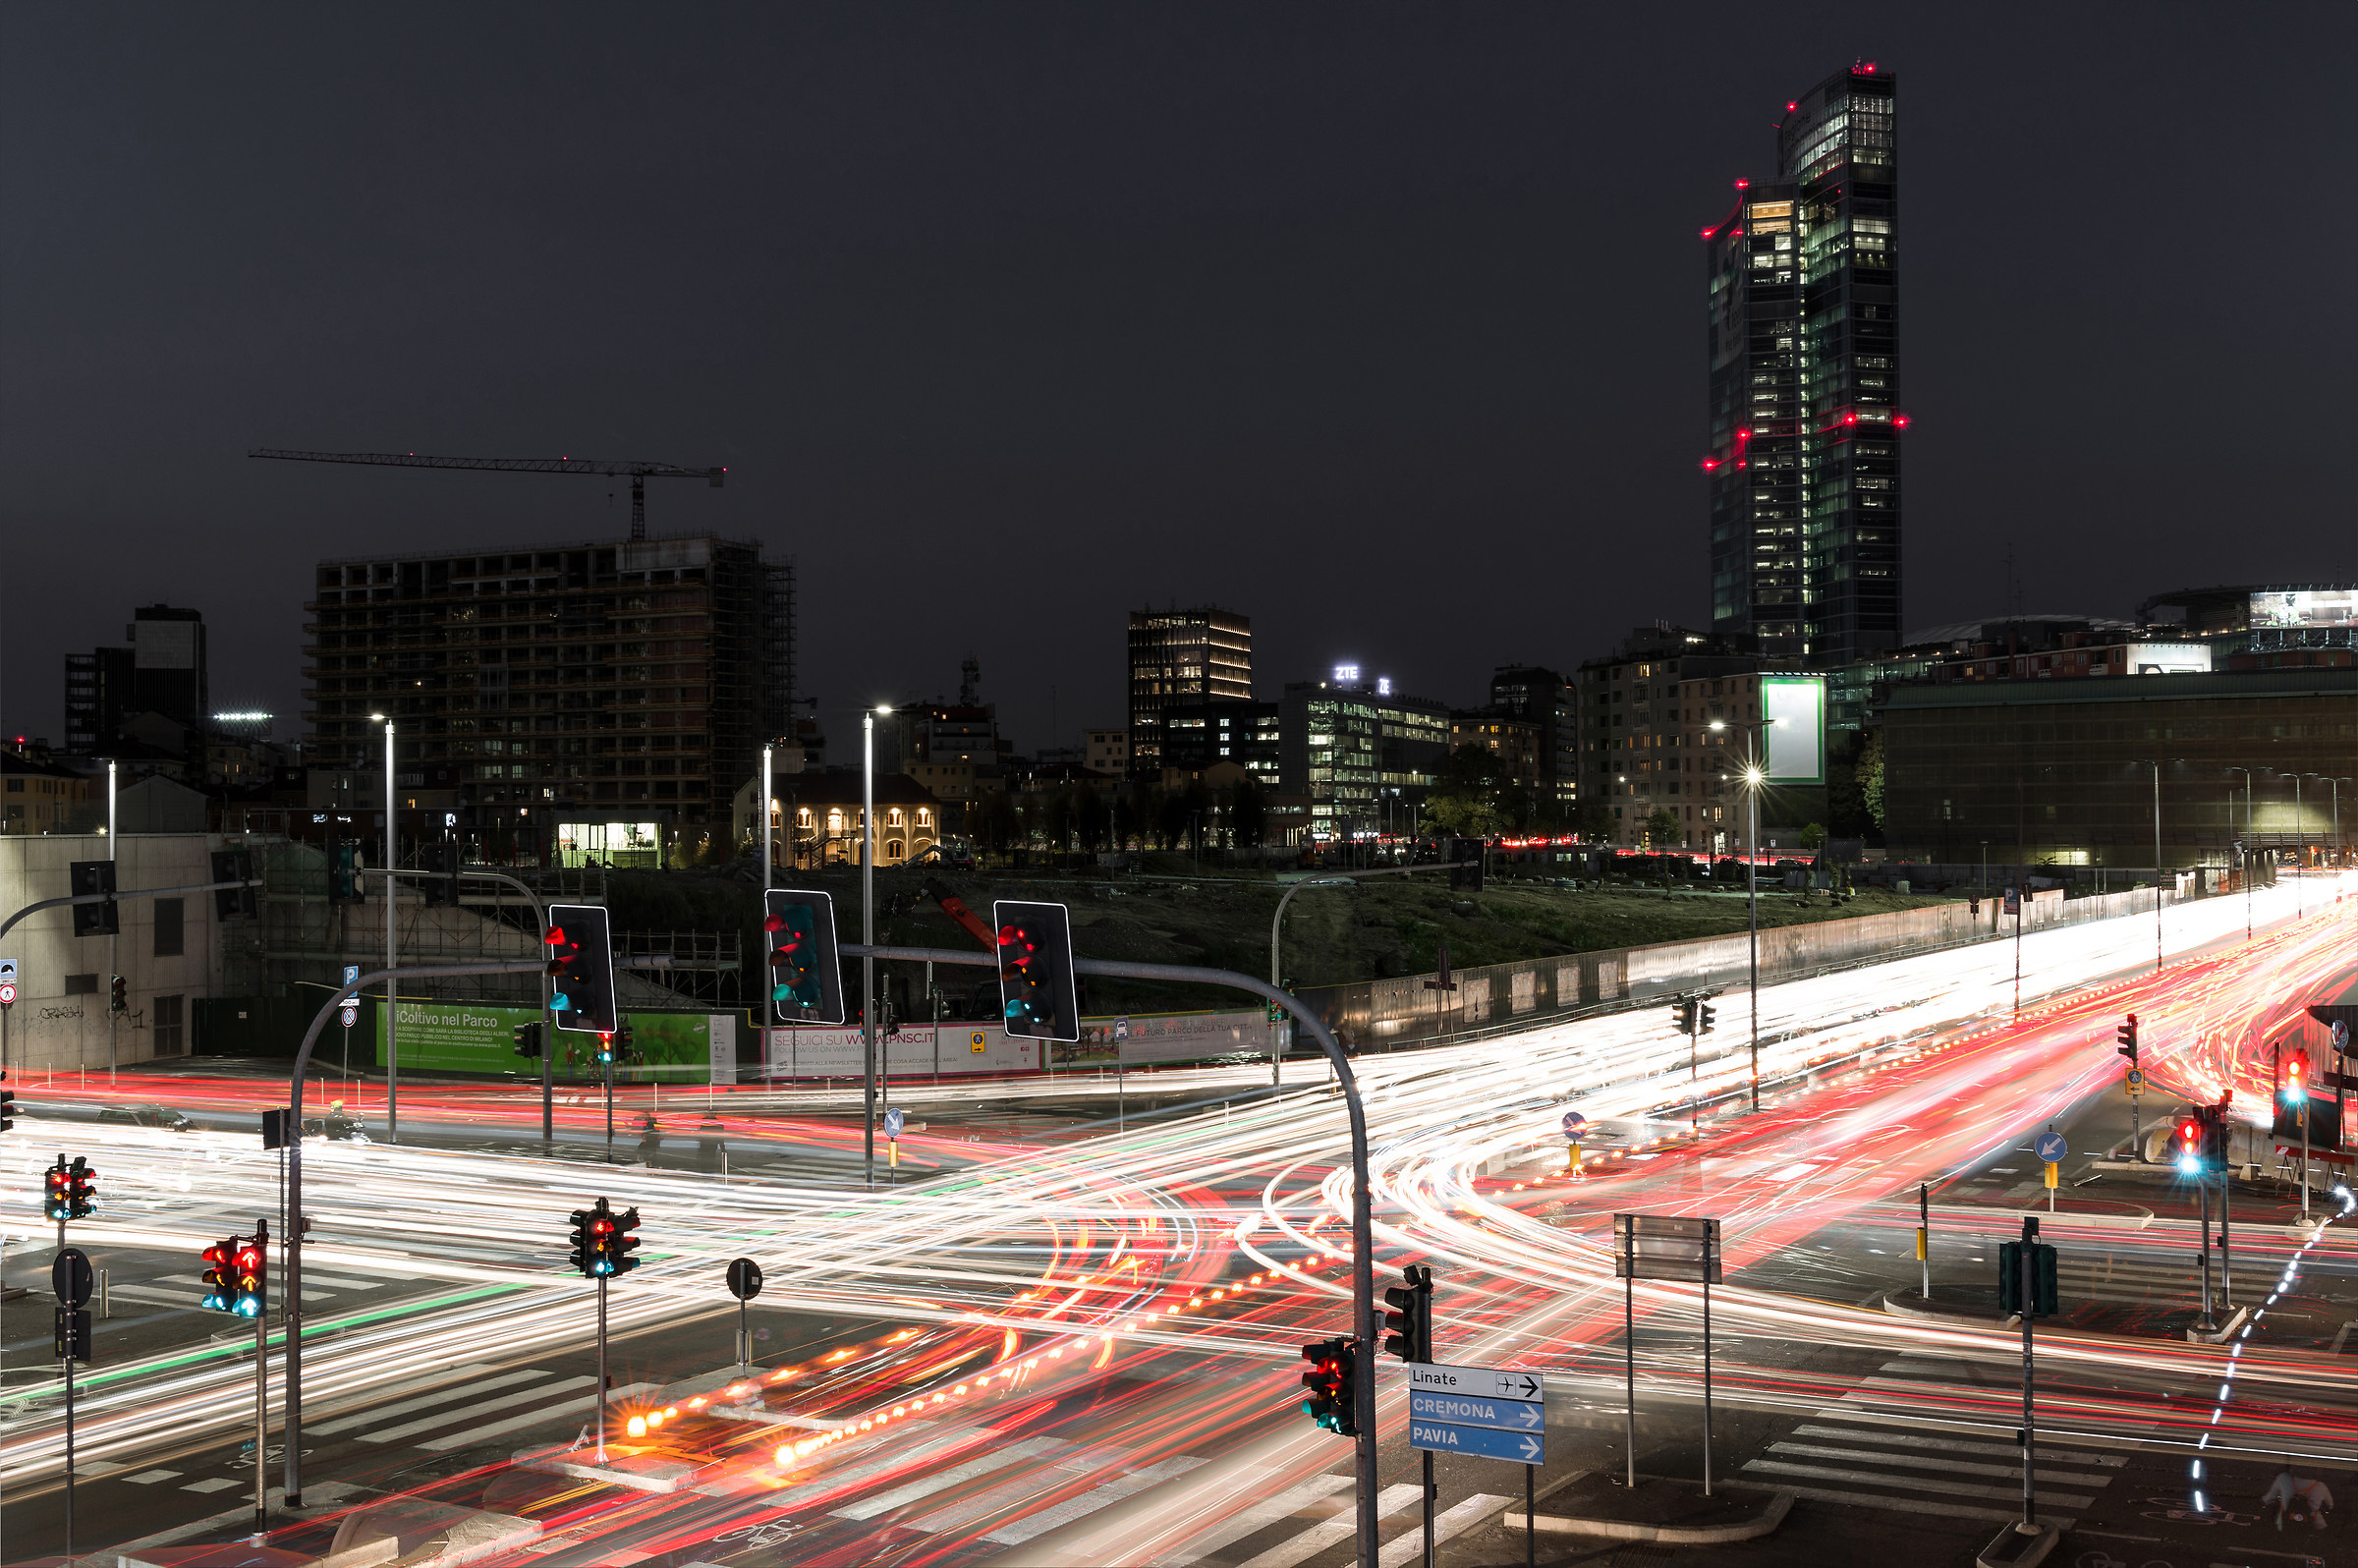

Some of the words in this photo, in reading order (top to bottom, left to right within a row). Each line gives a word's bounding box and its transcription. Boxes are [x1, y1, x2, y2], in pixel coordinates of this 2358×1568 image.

[1335, 666, 1358, 679] ZTE
[346, 969, 356, 984] P
[388, 1010, 439, 1025] iColtivo
[441, 1013, 460, 1026] nel
[463, 1014, 498, 1028] Parco
[774, 1035, 823, 1046] SEGUICI
[826, 1035, 843, 1045] SU
[1137, 1029, 1166, 1037] FUTURO
[1413, 1370, 1457, 1385] Linate
[1413, 1397, 1495, 1420] CREMONA
[1413, 1427, 1459, 1445] PAVIA
